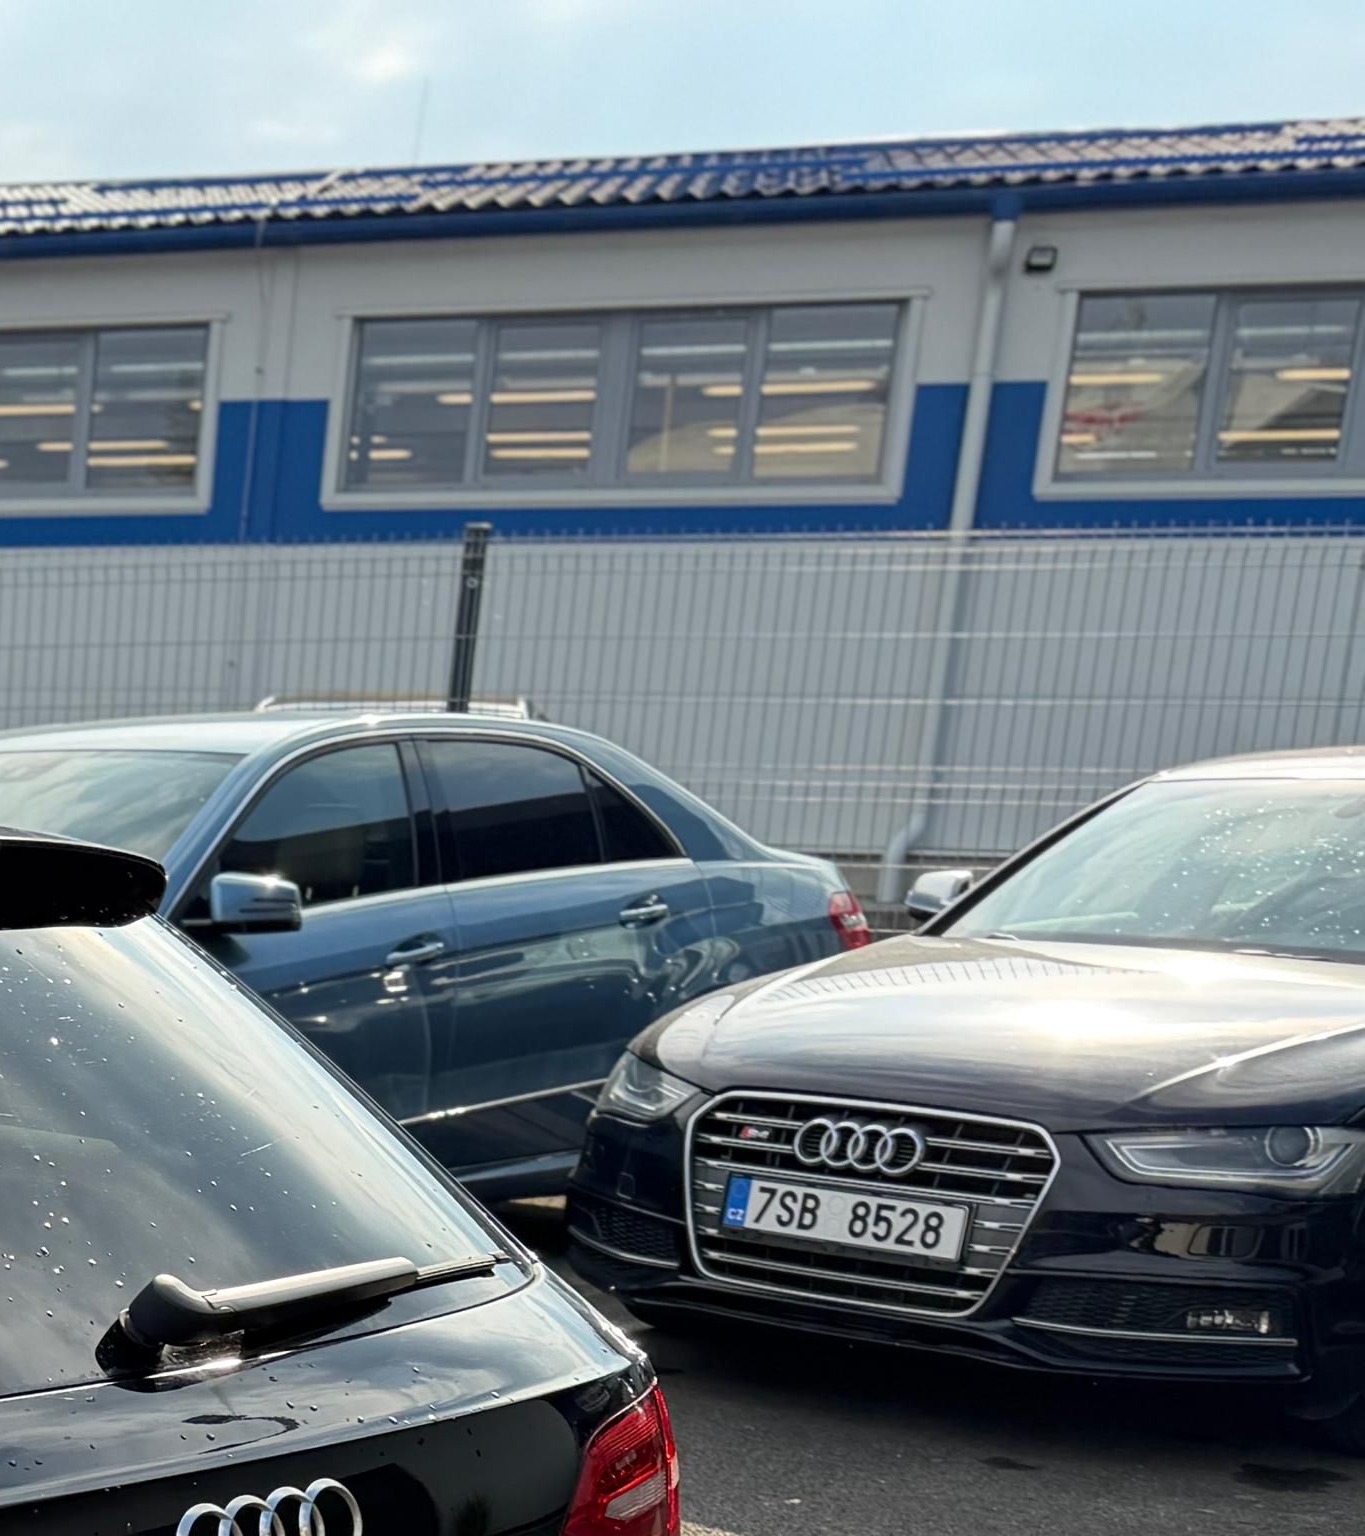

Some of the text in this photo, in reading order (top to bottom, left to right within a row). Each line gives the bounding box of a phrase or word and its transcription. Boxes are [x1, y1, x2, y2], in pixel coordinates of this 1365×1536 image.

[726, 1208, 746, 1222] CZ
[753, 1186, 944, 1250] 7SB 8528
